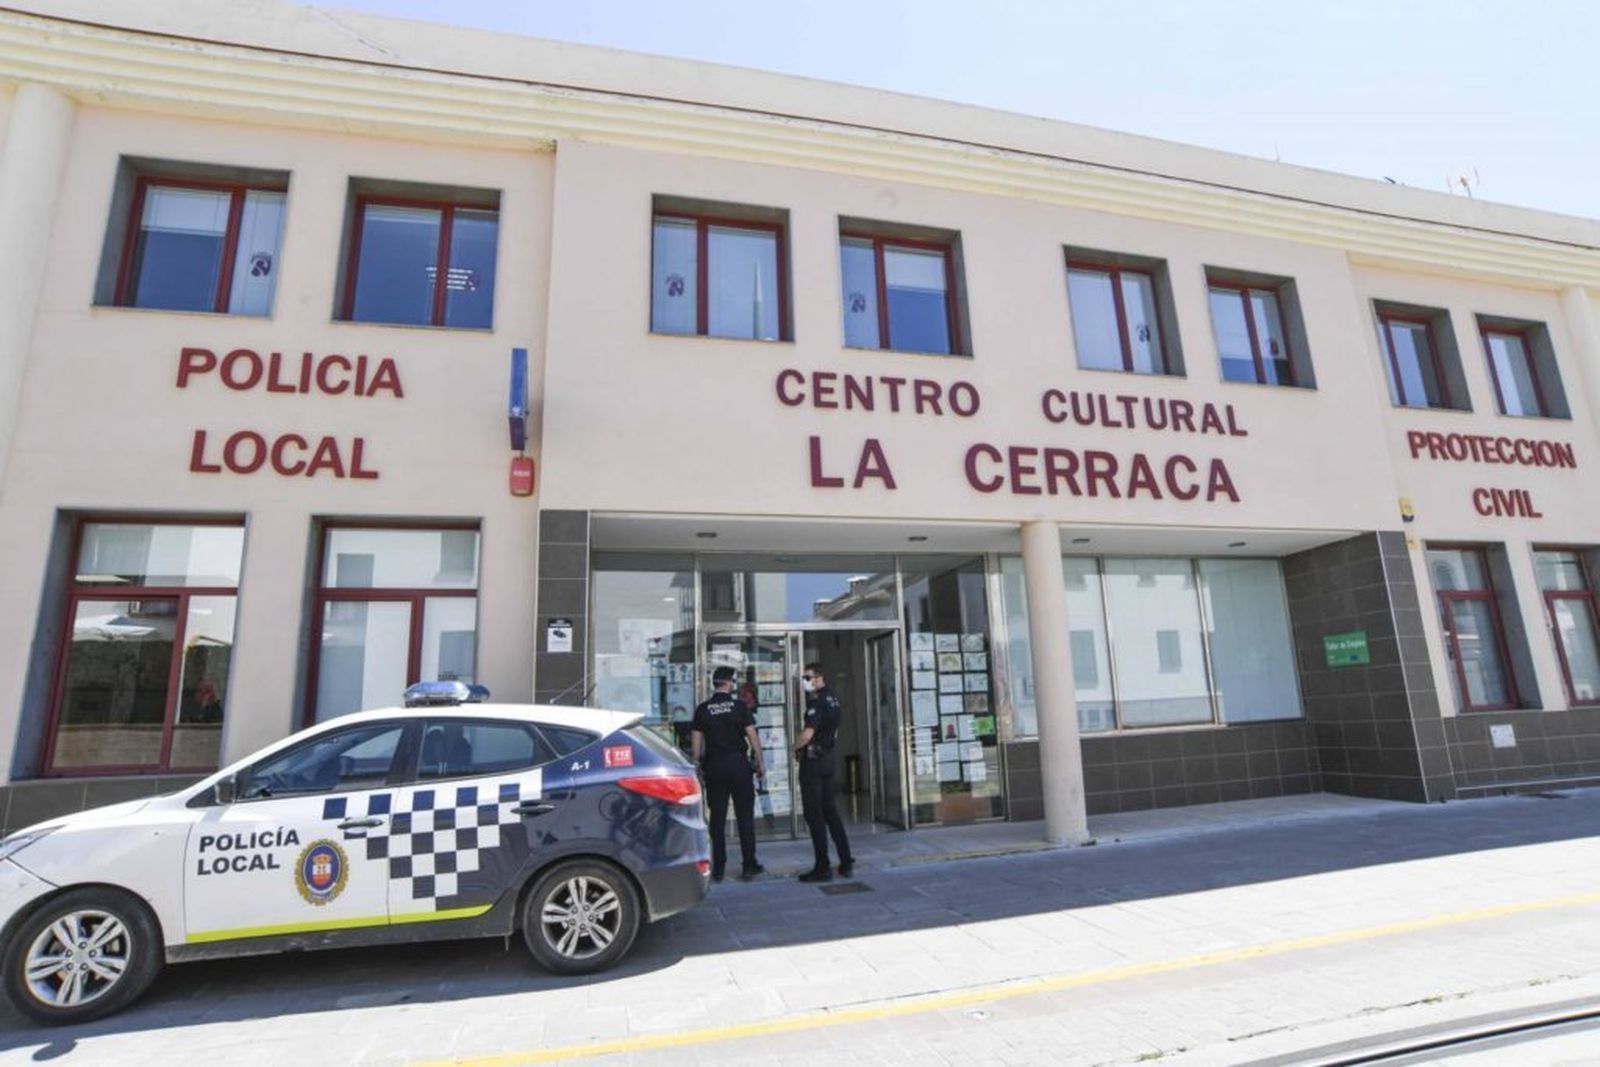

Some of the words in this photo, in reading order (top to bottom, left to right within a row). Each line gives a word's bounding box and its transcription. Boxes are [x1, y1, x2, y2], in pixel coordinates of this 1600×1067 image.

[176, 347, 404, 398] POLICIA
[775, 369, 981, 417] CENTRO
[1041, 388, 1248, 437] CULTURAL
[189, 430, 379, 479] LOCAL
[1407, 431, 1577, 469] PROTECCION
[809, 436, 897, 490] LA
[964, 442, 1241, 503] CERRACA
[1472, 487, 1543, 519] CIVIL
[570, 759, 590, 771] A-1
[198, 826, 300, 852] POLICÍA
[197, 853, 281, 875] LOCAL
